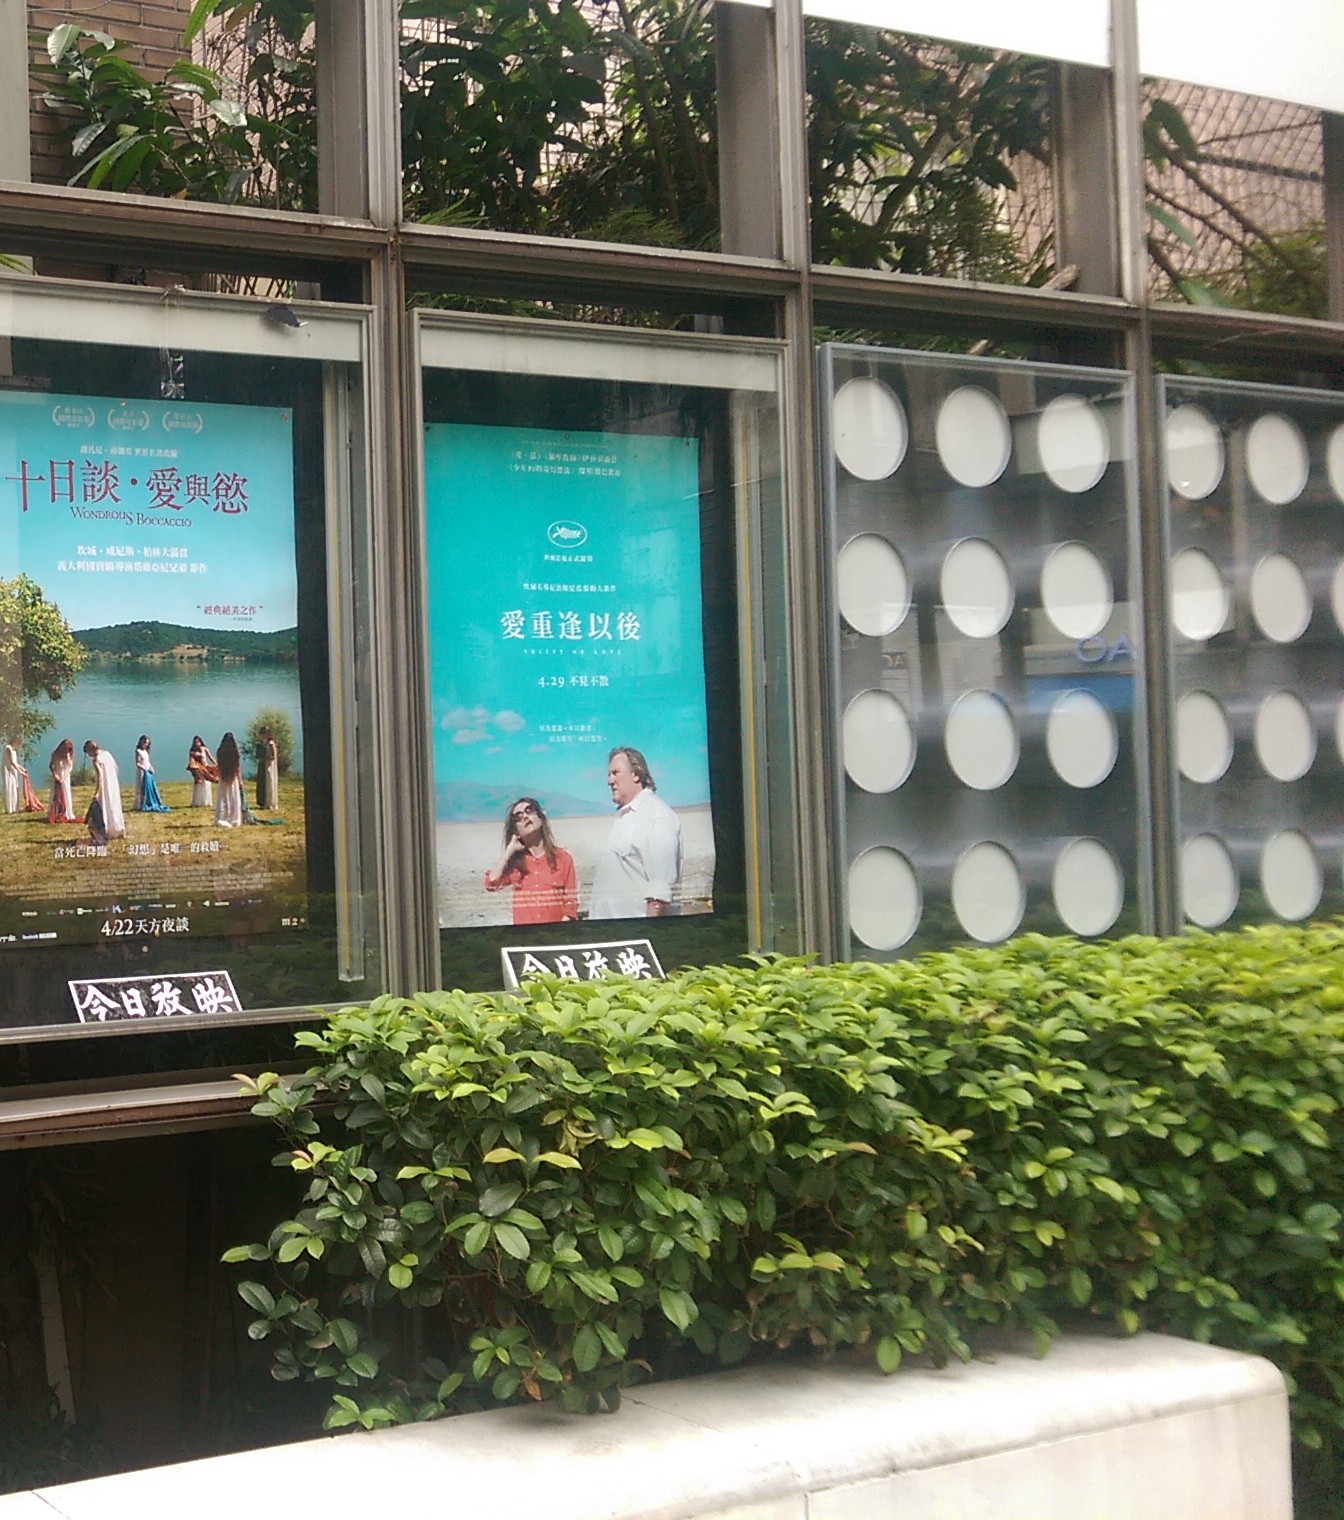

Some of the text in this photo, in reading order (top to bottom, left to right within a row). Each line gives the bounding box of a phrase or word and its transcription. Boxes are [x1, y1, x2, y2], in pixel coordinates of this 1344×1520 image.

[500, 609, 642, 642] 愛重逢以後
[537, 675, 566, 689] 4.29
[80, 977, 234, 1022] 今日放映
